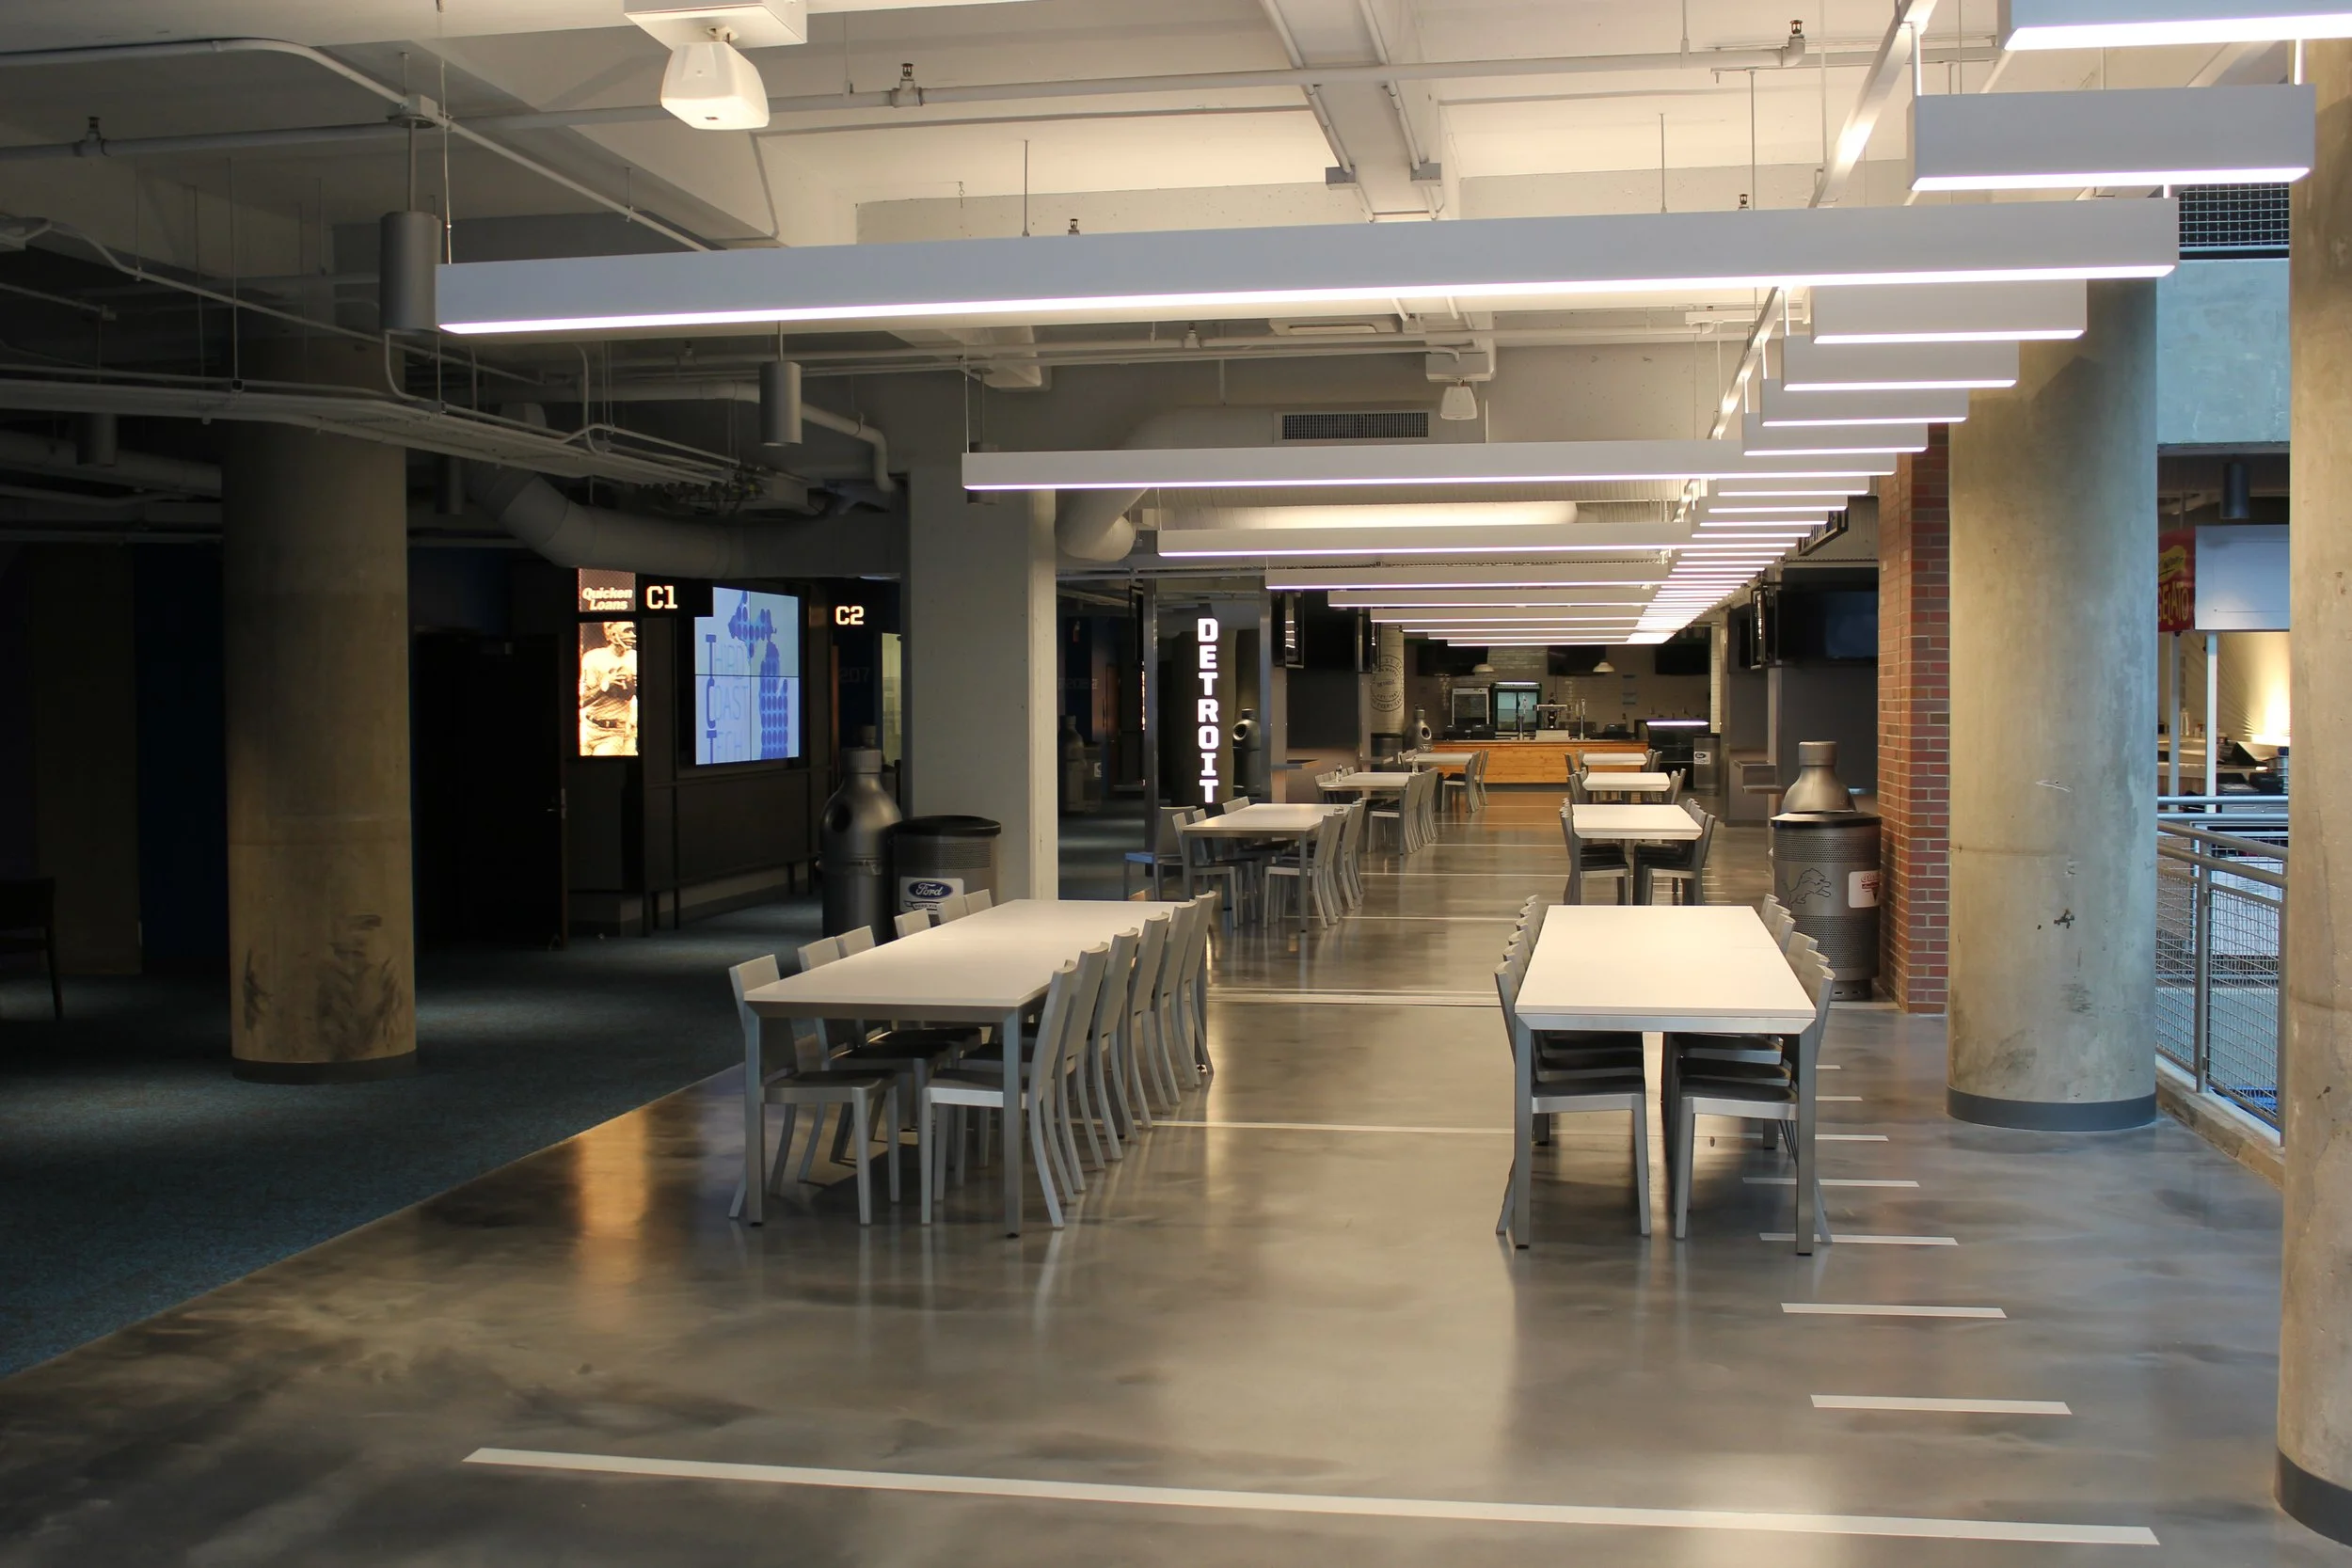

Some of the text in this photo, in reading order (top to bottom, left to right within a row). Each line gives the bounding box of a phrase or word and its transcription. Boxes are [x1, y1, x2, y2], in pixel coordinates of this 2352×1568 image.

[582, 587, 633, 600] Quicken
[646, 585, 677, 610] C1
[589, 599, 628, 610] Loans
[835, 605, 865, 626] C2
[1197, 617, 1219, 803] DETROIT
[915, 882, 944, 896] Ford
